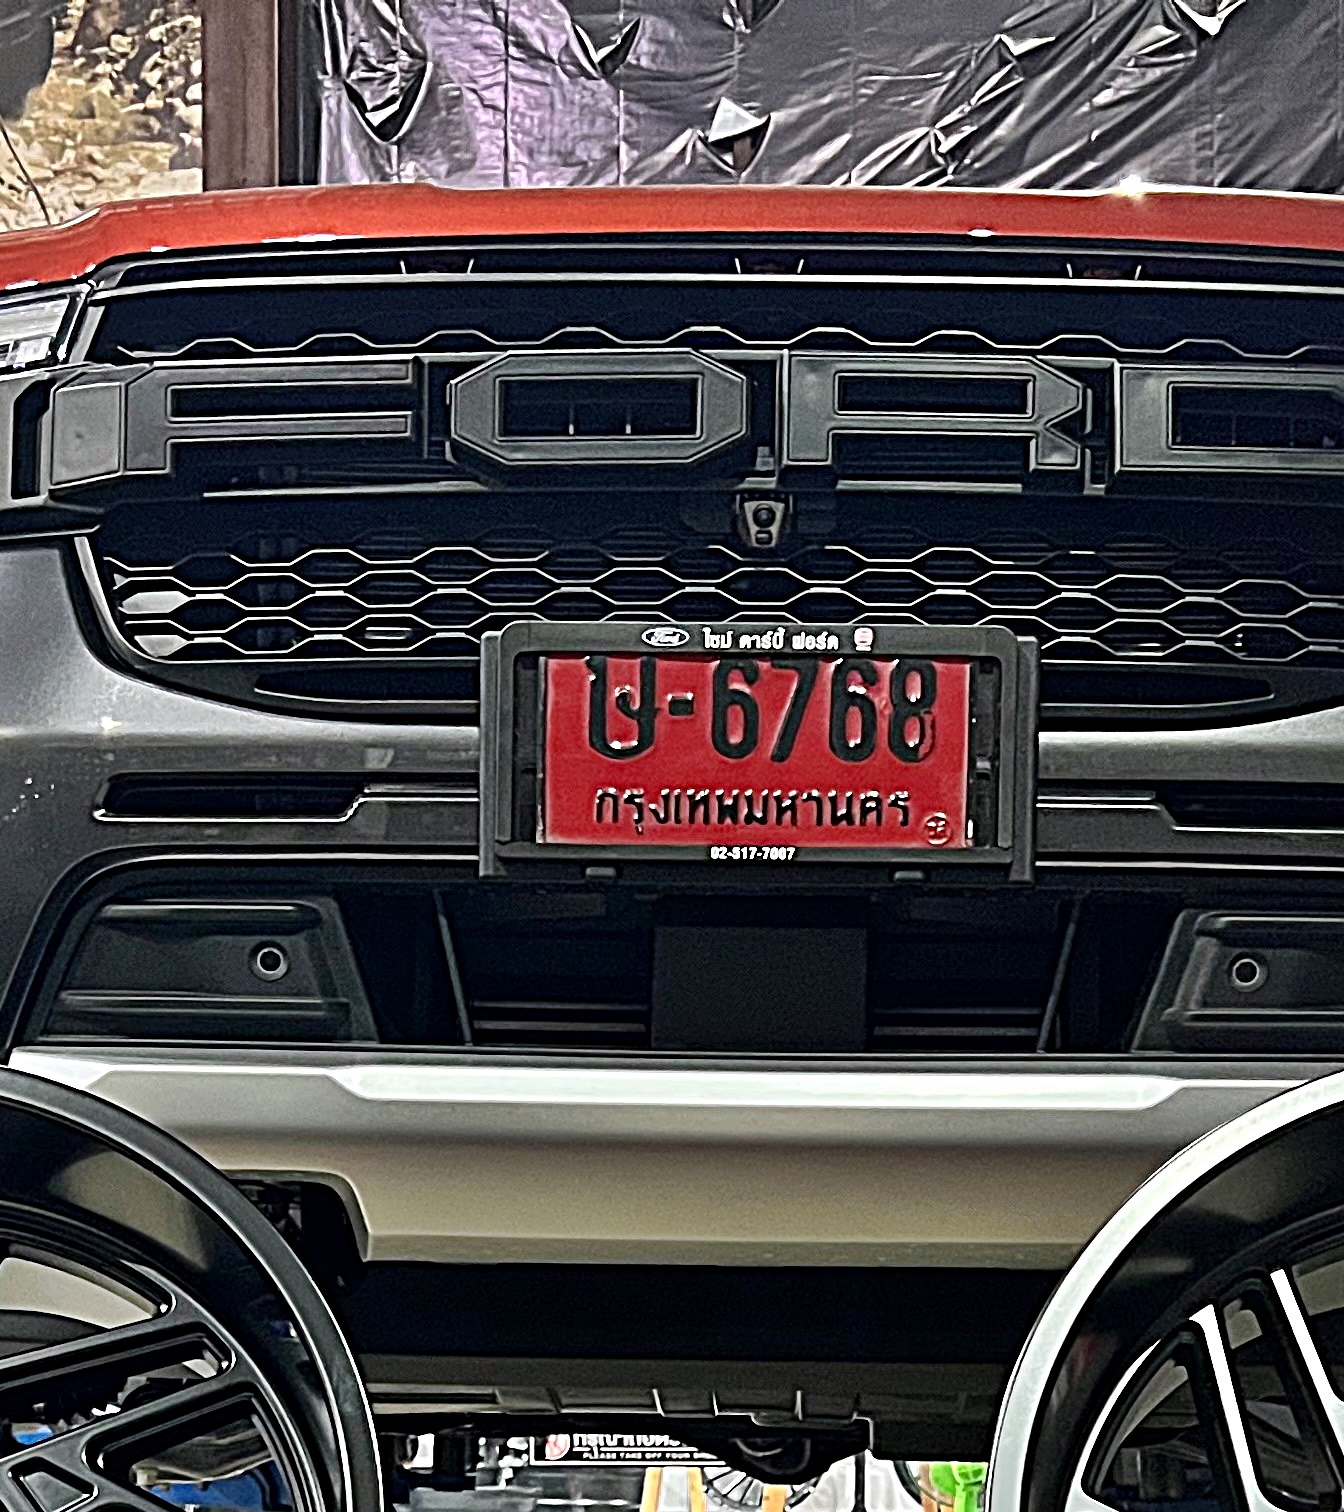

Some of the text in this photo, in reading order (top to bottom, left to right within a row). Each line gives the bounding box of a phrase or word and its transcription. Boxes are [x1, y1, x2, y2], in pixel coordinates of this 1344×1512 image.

[595, 787, 910, 835] กรุงเทพมหานคร
